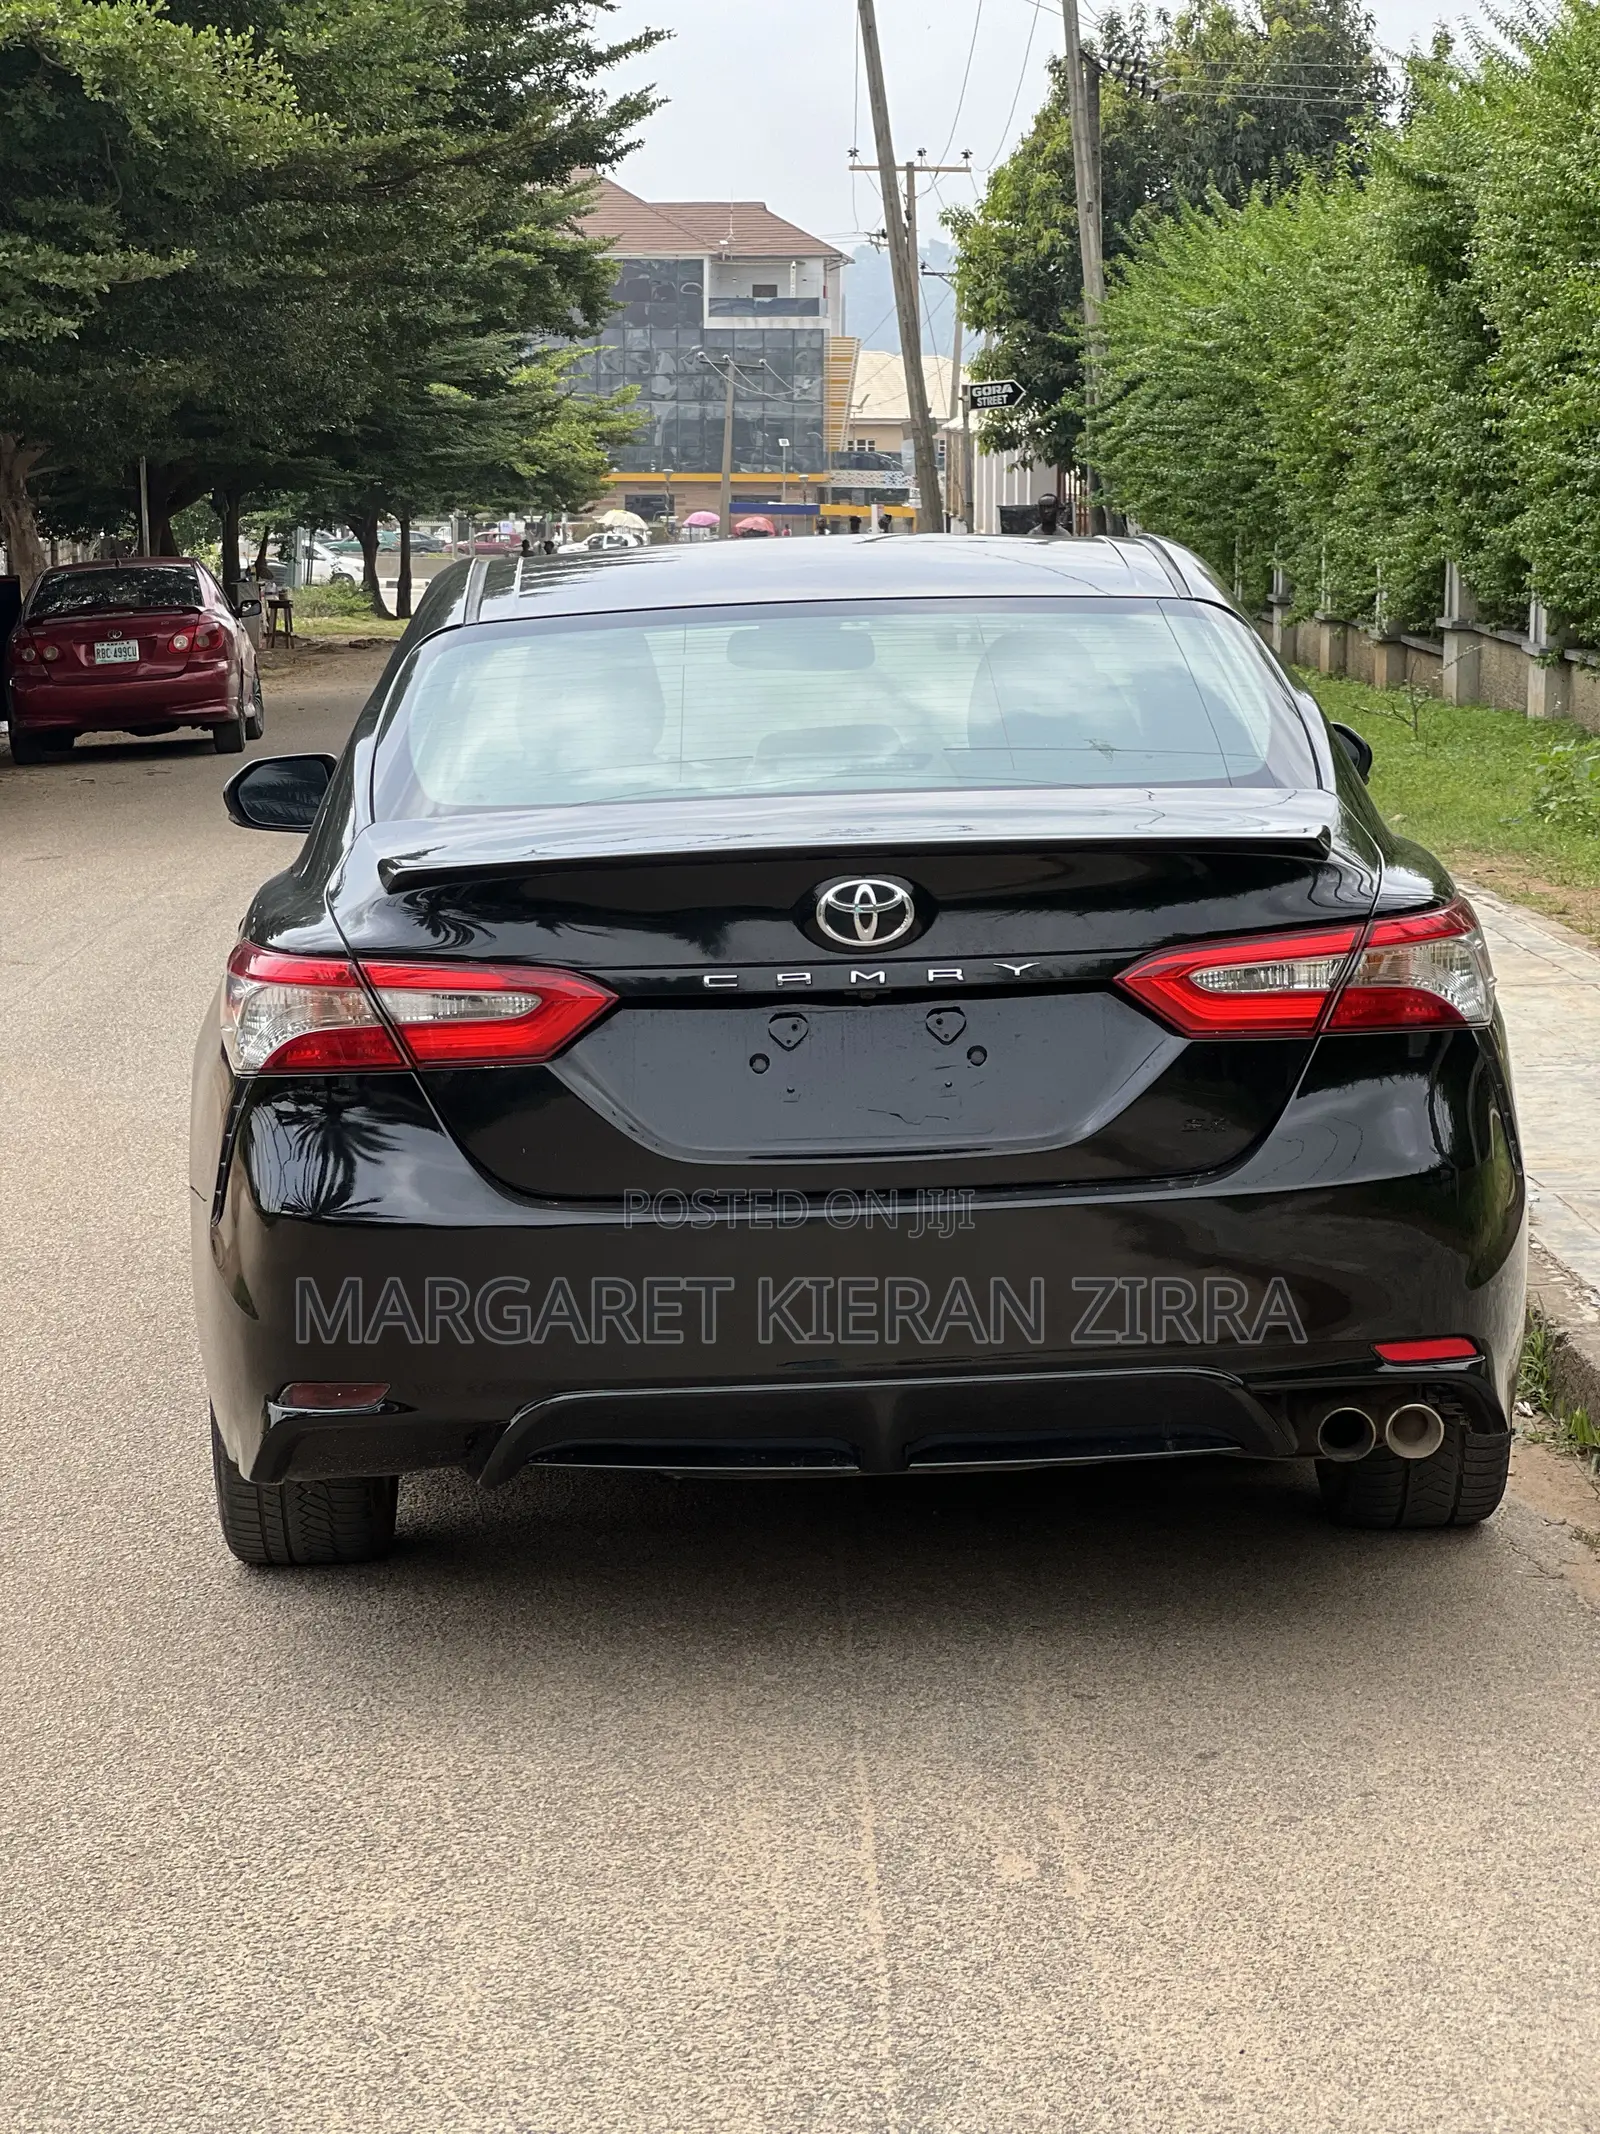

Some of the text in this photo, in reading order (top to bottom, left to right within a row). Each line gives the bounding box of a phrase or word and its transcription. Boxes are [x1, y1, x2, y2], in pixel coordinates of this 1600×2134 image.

[972, 384, 1014, 397] GORA
[976, 394, 1008, 407] STREET
[703, 962, 1040, 988] CAMRY
